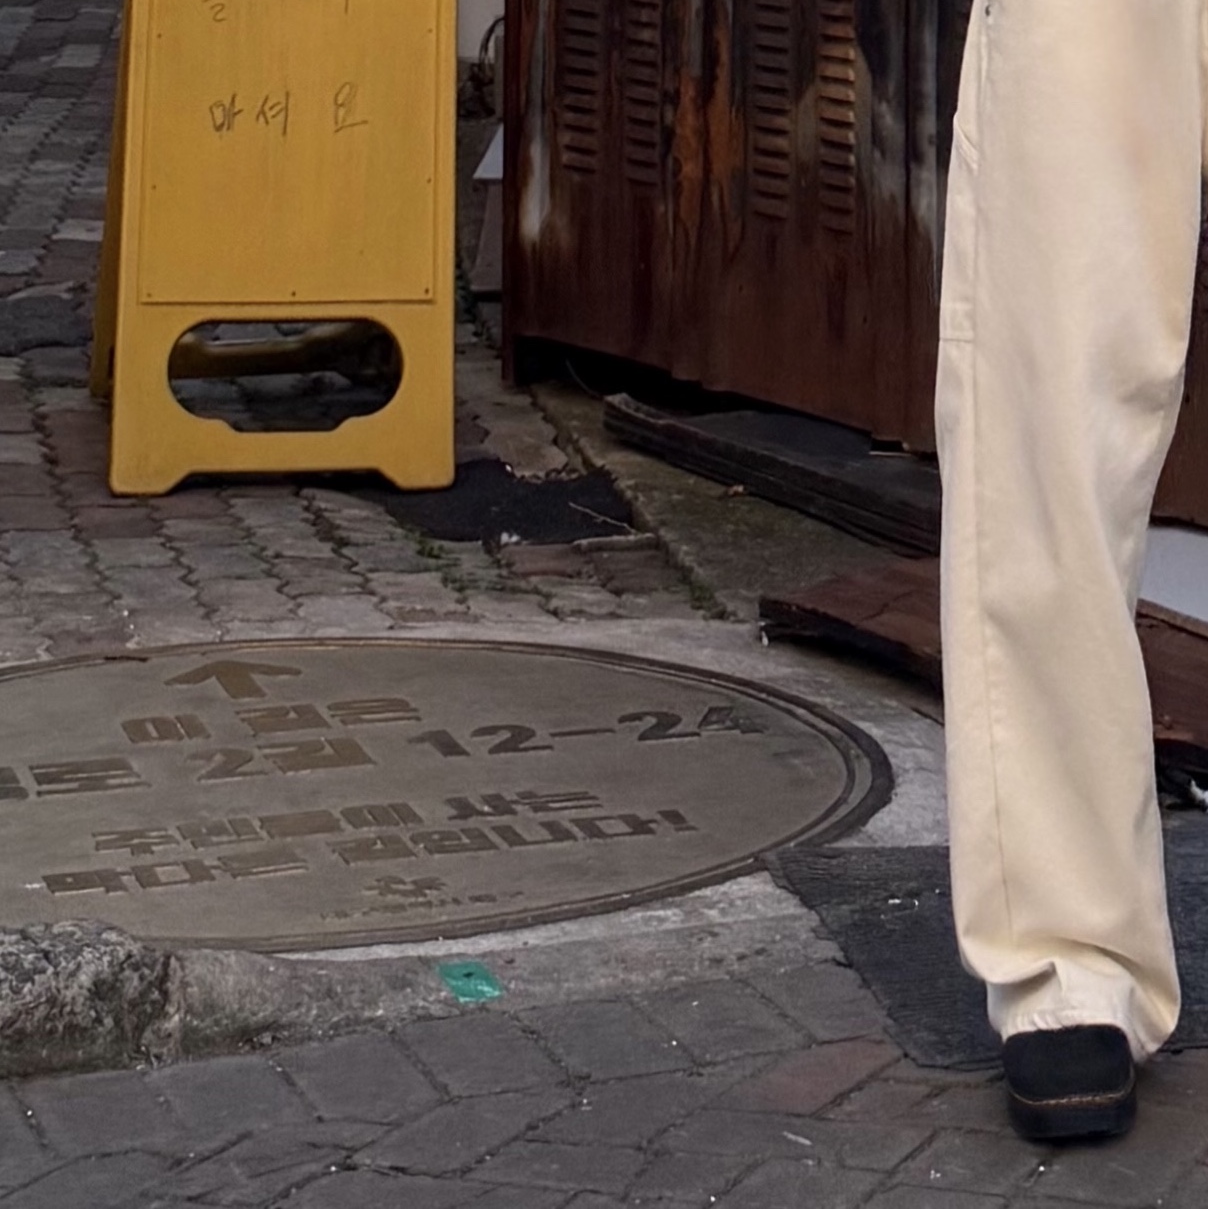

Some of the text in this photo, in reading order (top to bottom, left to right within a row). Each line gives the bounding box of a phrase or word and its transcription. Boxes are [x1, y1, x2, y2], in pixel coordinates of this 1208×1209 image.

[121, 698, 421, 745] 이 길은
[0, 706, 765, 799] 로 2길 12-24
[446, 791, 603, 821] 사는
